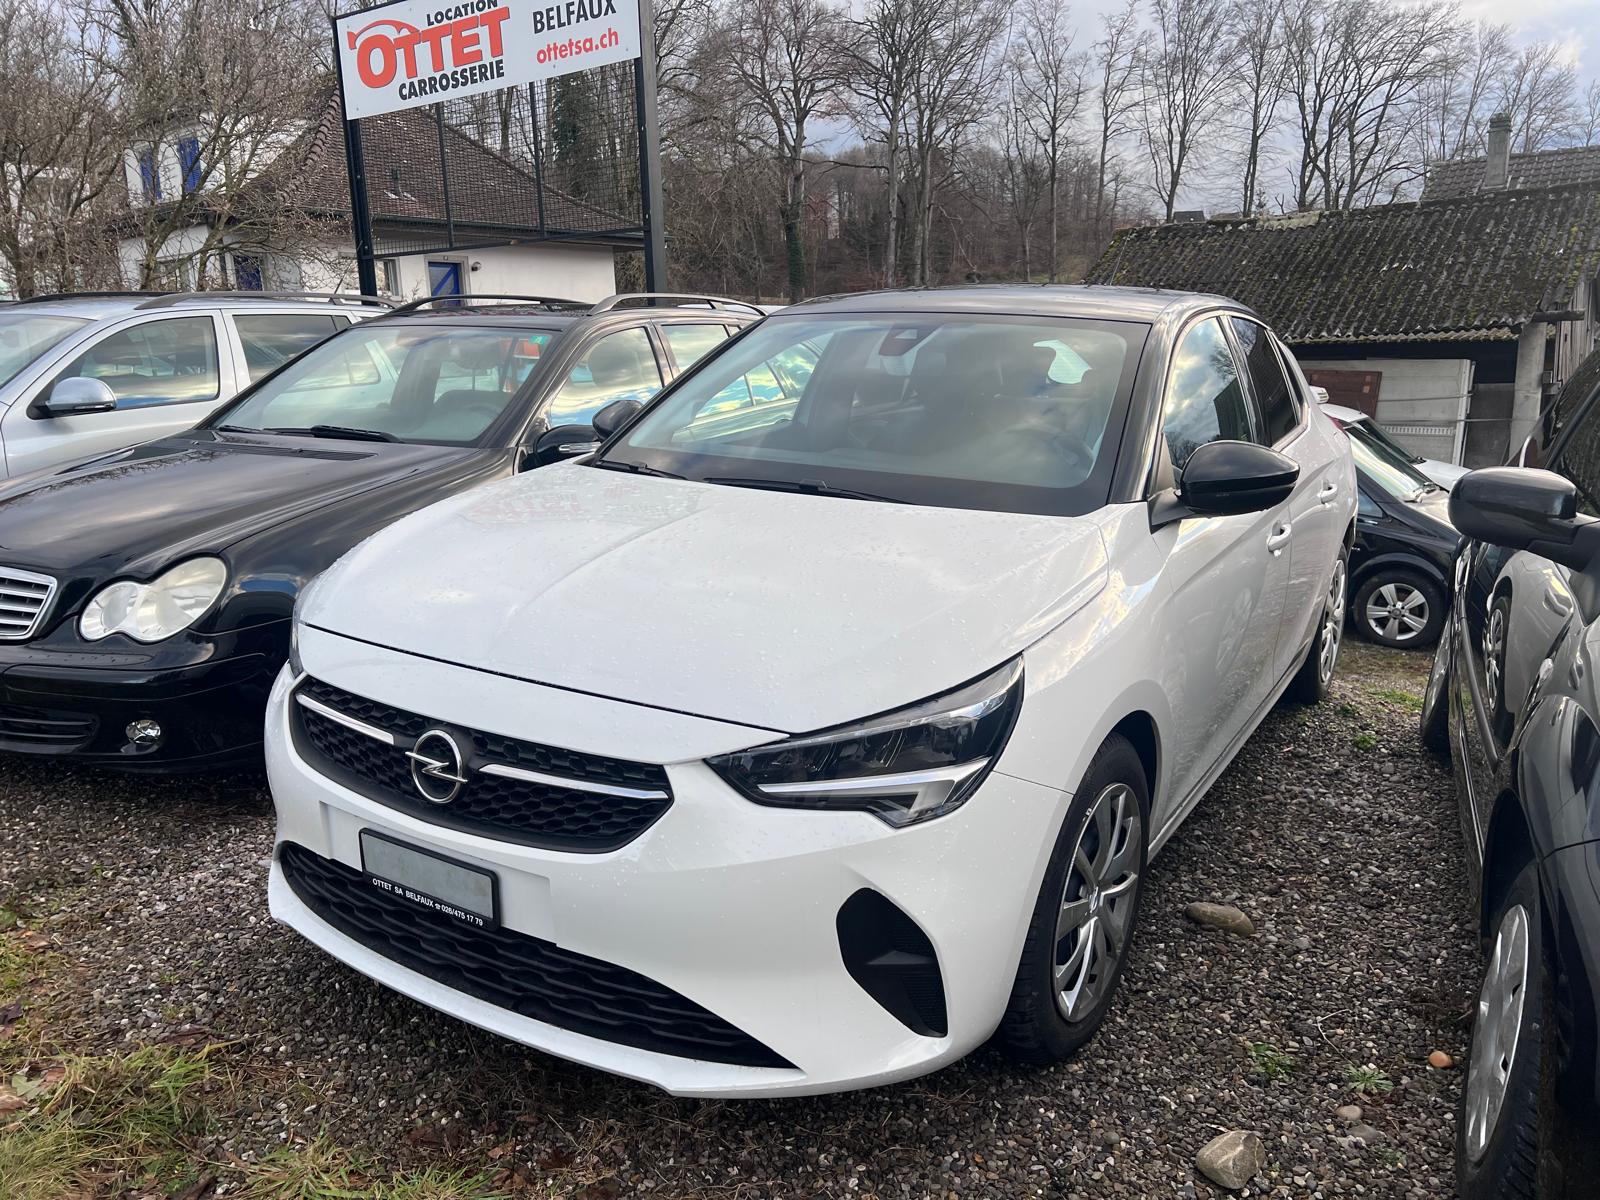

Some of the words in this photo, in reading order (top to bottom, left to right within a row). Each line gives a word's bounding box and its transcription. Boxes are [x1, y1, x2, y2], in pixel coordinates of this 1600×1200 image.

[426, 0, 498, 26] LOCATION
[532, 0, 617, 34] BELFAUX
[357, 6, 511, 89] OTTET
[536, 27, 619, 64] ottetsa.ch
[398, 59, 505, 101] CARROSSERIE
[372, 878, 392, 891] OTTET
[394, 886, 404, 896] SA
[405, 890, 434, 908] BELFAUX
[466, 914, 474, 922] 17
[475, 917, 483, 926] 79
